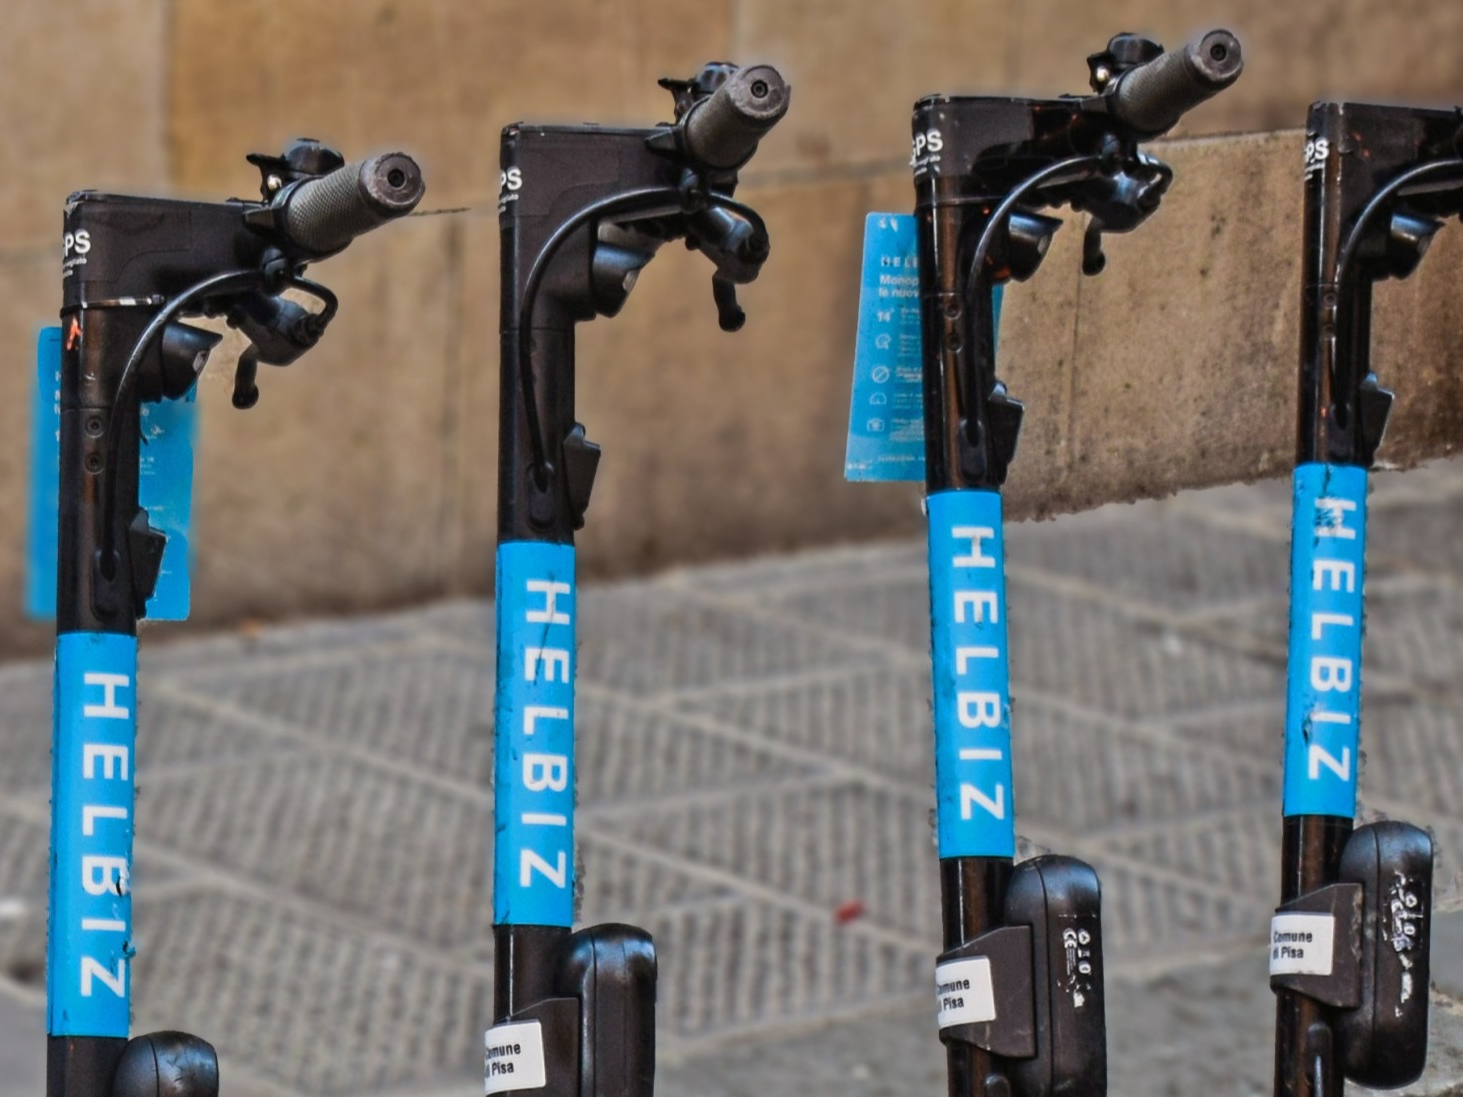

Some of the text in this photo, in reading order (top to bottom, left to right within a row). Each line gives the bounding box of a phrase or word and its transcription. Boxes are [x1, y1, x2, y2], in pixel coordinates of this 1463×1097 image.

[911, 128, 944, 156] PS
[1305, 137, 1329, 163] PS
[64, 229, 91, 257] PS
[879, 274, 920, 290] Monop
[892, 288, 920, 298] nuov
[1306, 497, 1357, 783] HELBIZ
[951, 525, 1005, 821] HELBIZ
[518, 578, 571, 889] HELBIZ
[79, 671, 131, 998] HELBIZ
[1281, 946, 1305, 959] Pisa
[943, 997, 965, 1011] Pisa
[491, 1062, 515, 1076] Pisa
